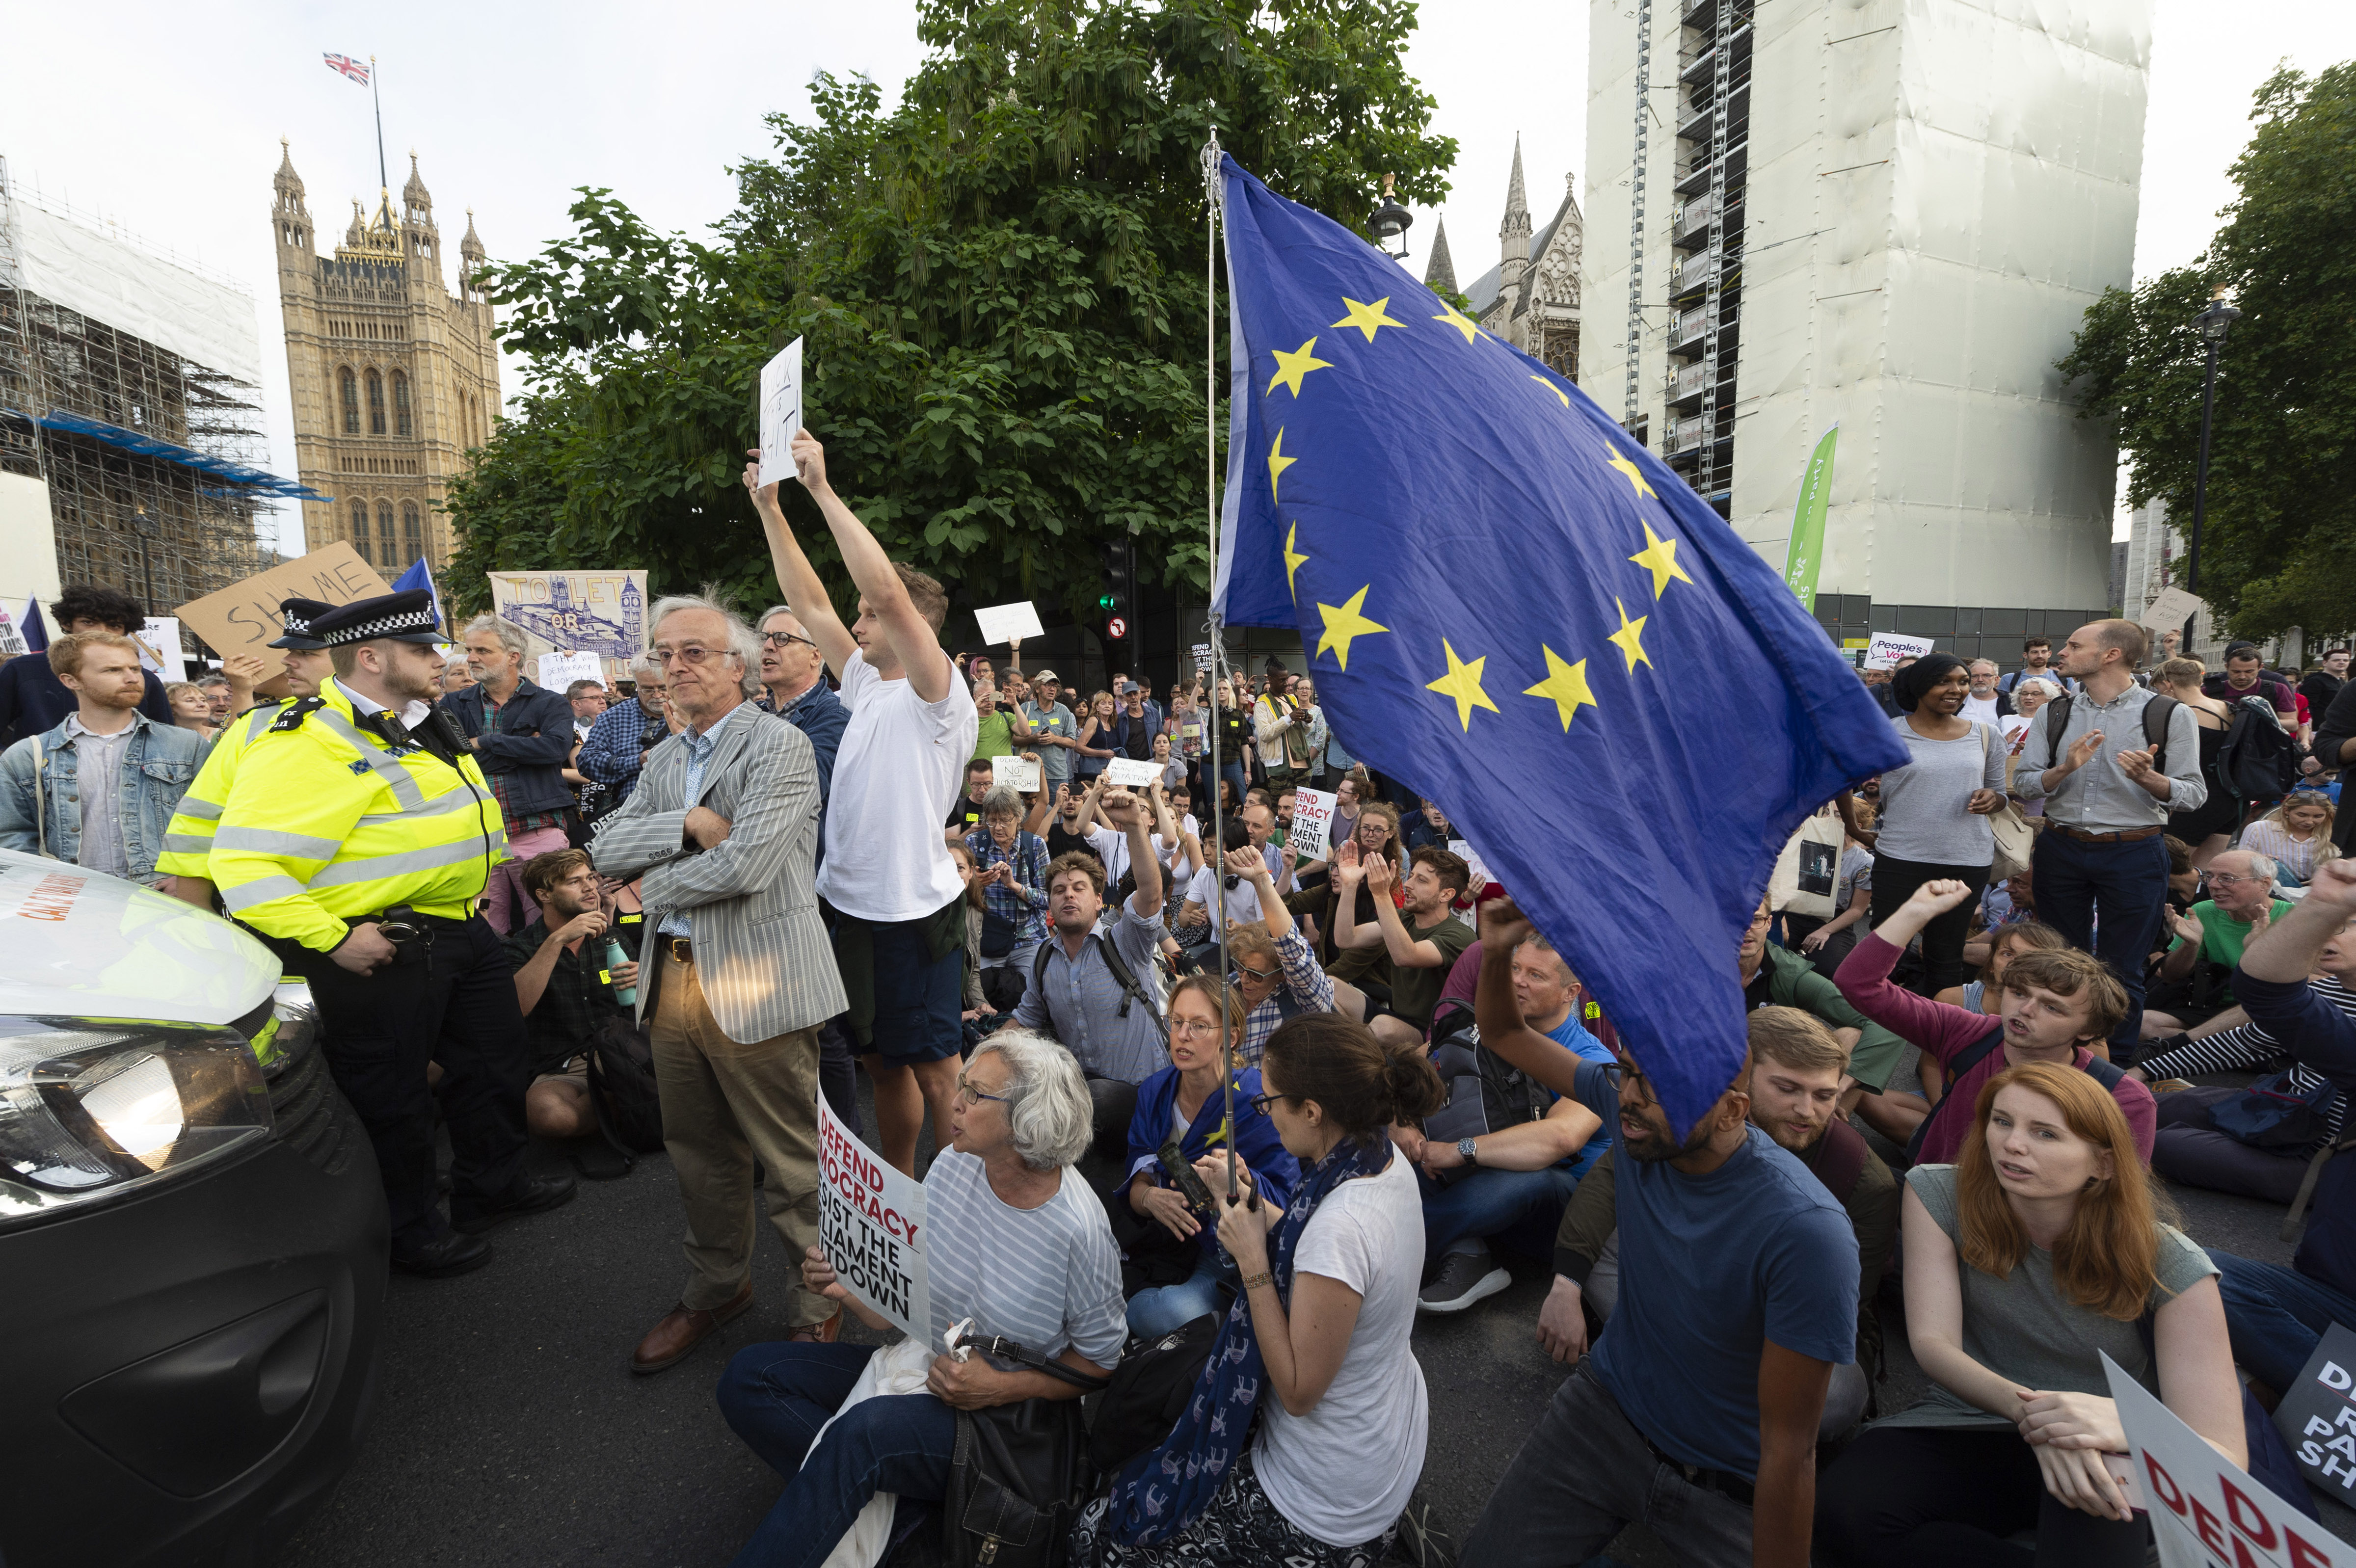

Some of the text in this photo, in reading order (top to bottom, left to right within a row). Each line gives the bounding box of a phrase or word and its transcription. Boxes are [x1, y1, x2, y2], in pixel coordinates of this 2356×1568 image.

[764, 355, 791, 402] FUCK
[506, 577, 625, 603] TO LET
[551, 612, 579, 629] OR
[138, 632, 152, 640] OU!
[1877, 640, 1923, 653] People's
[543, 656, 549, 664] IS
[1886, 650, 1905, 659] Vot
[547, 664, 590, 676] DEMOCRACY
[549, 676, 574, 686] LOOKS
[1005, 766, 1027, 775] NOT
[994, 778, 1039, 788] DICTATORSHIP
[1111, 771, 1150, 784] DICTATOR
[1296, 791, 1318, 804] EFEND
[1302, 819, 1319, 831] THE
[32, 883, 81, 898] VAN
[27, 896, 75, 904] &
[16, 902, 71, 921] CAR
[822, 1108, 884, 1193] DEFEND
[818, 1128, 918, 1247] MOCRACY
[819, 1170, 900, 1269] ESIST THE
[818, 1205, 912, 1299] RLIAMENT
